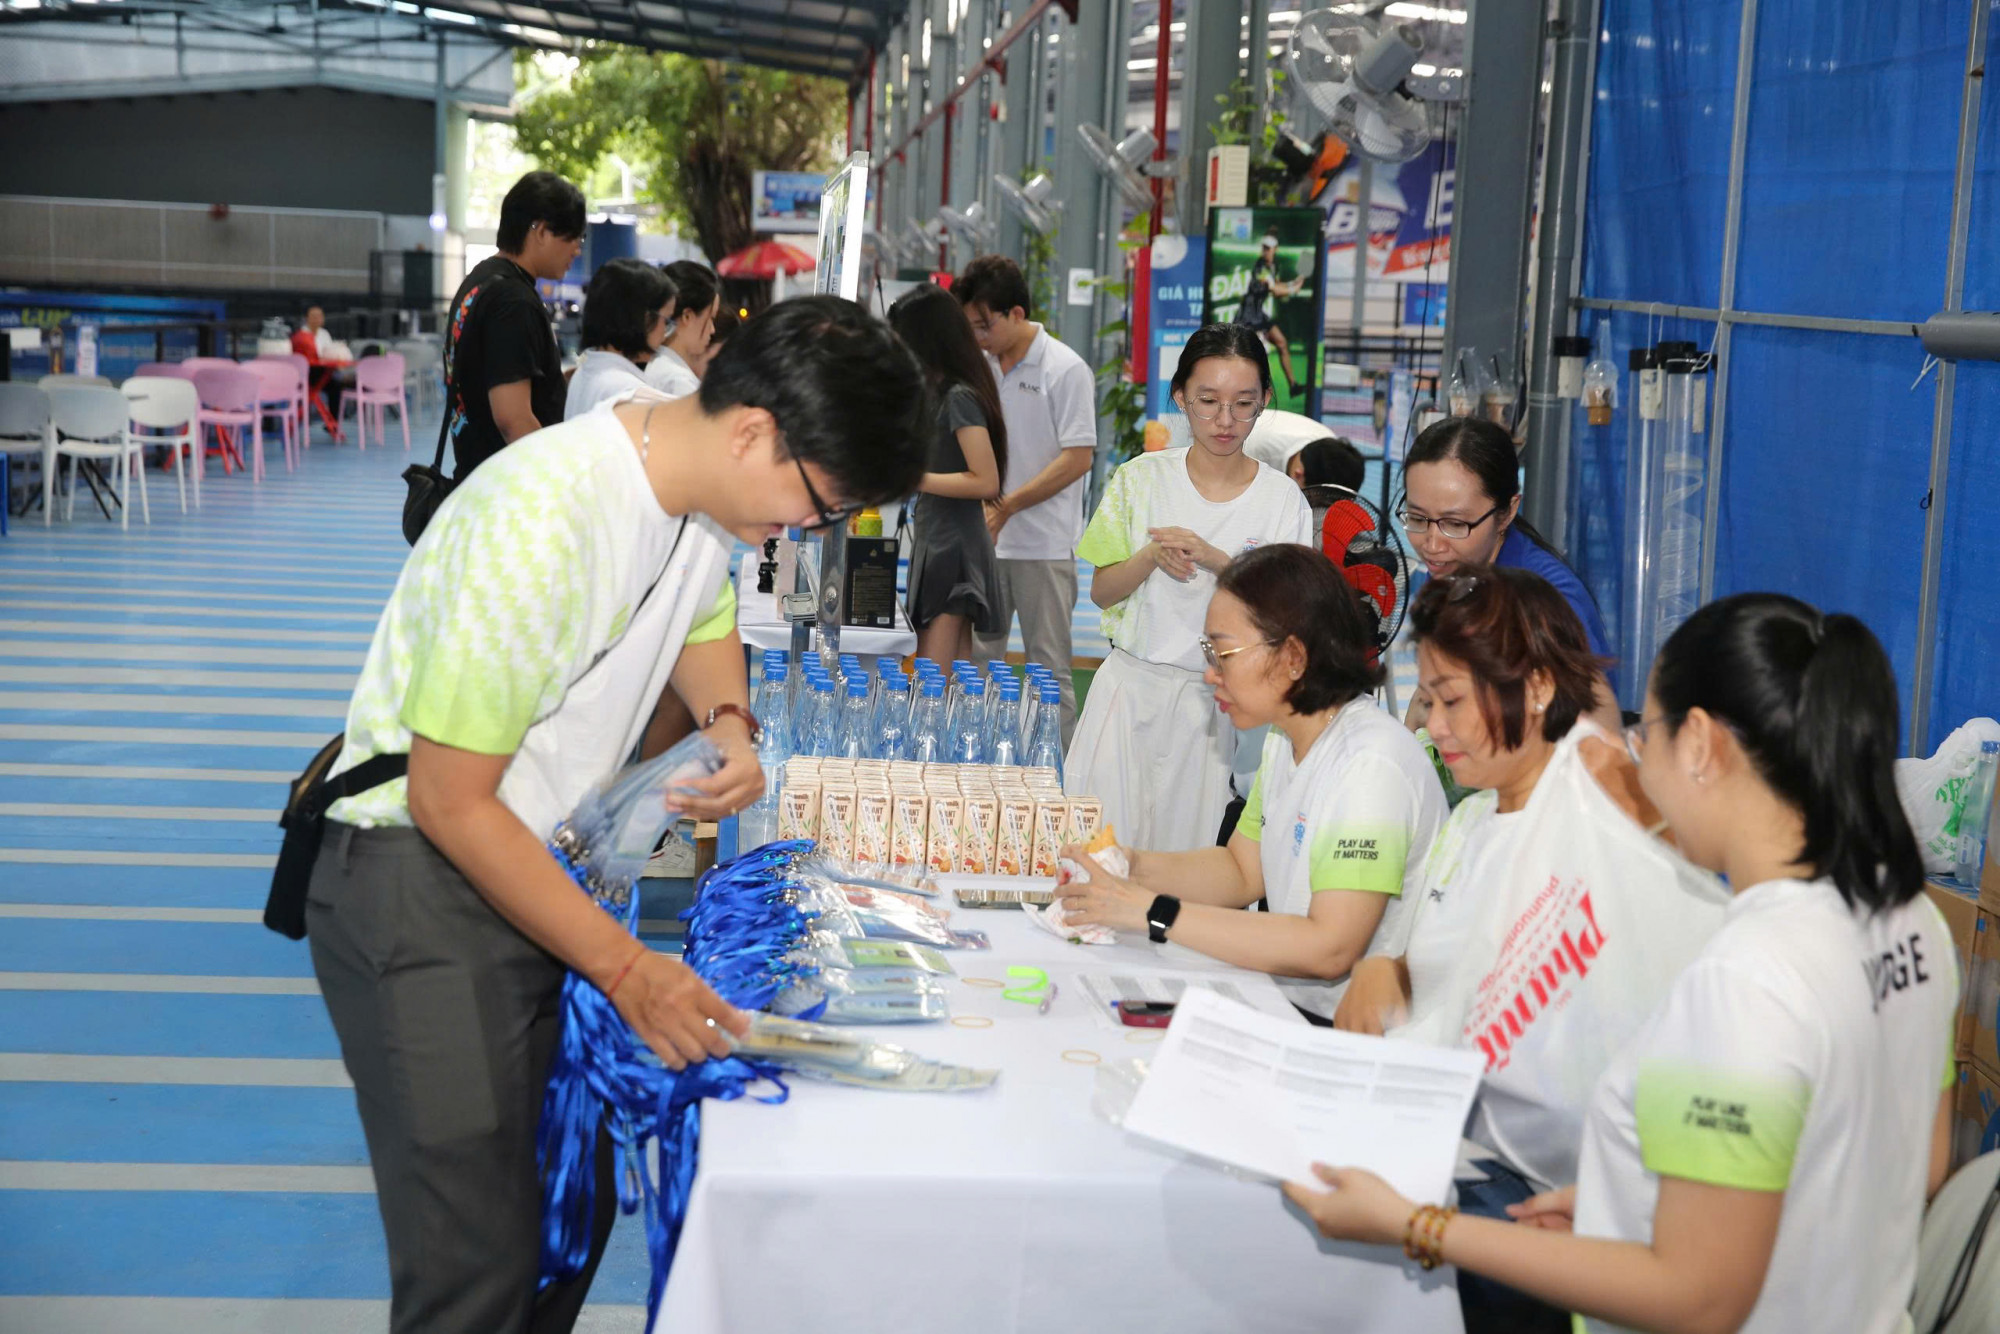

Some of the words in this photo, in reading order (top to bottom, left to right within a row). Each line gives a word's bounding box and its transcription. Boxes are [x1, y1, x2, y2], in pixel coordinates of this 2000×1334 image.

[1338, 839, 1357, 849] PLAY
[1359, 839, 1377, 849] LIKE
[1333, 850, 1341, 859] IT
[1342, 850, 1379, 860] MATTERS
